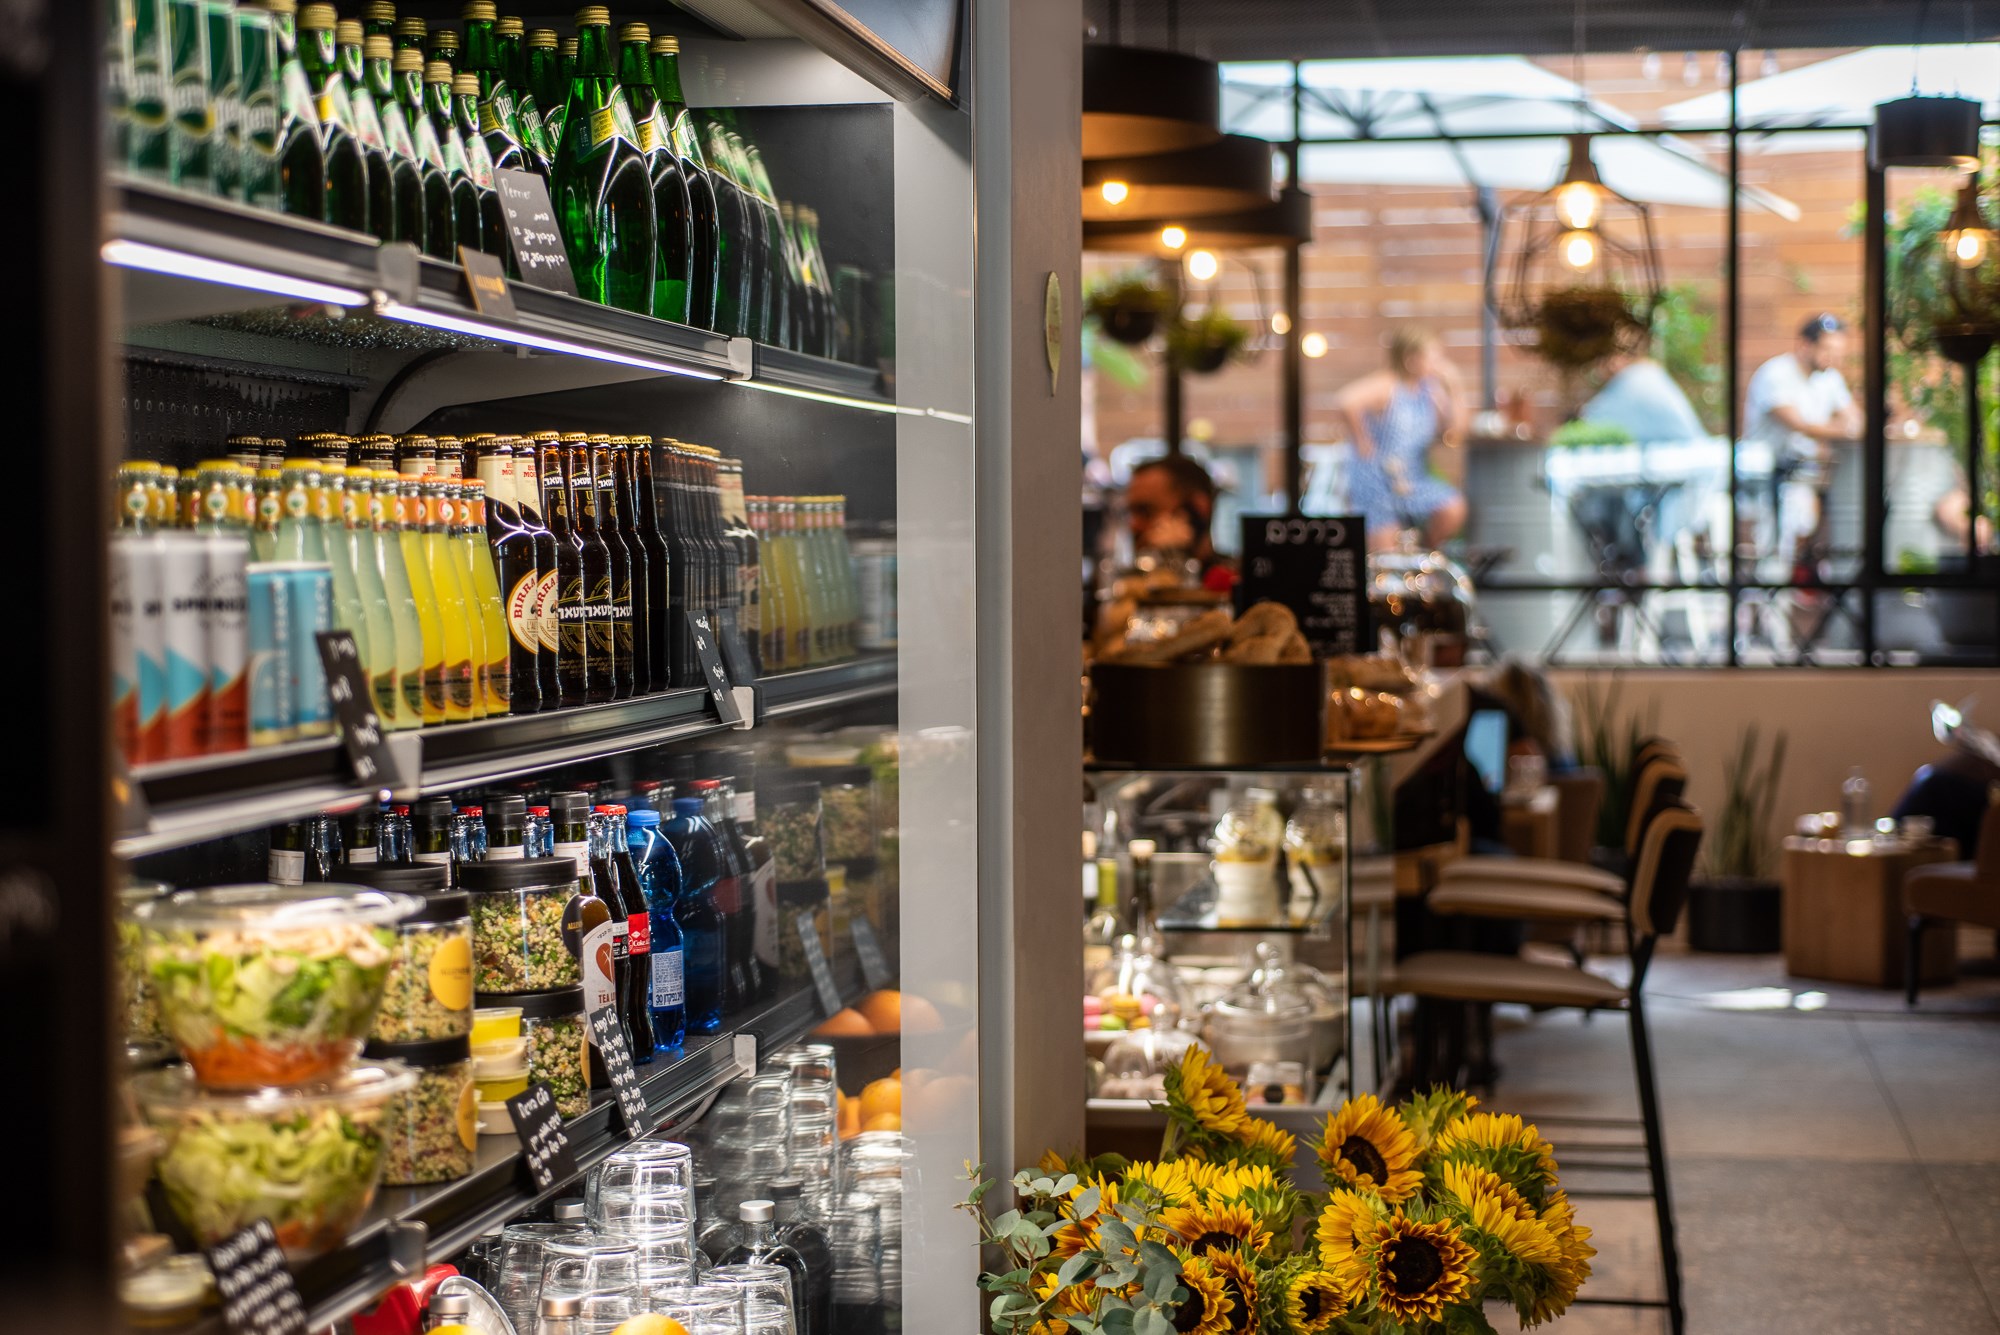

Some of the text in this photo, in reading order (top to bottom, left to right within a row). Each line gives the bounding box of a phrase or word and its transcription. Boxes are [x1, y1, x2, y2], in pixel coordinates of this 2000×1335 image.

[500, 177, 531, 200] Perrier
[513, 577, 536, 619] BIRRA
[598, 992, 610, 1004] TEA
